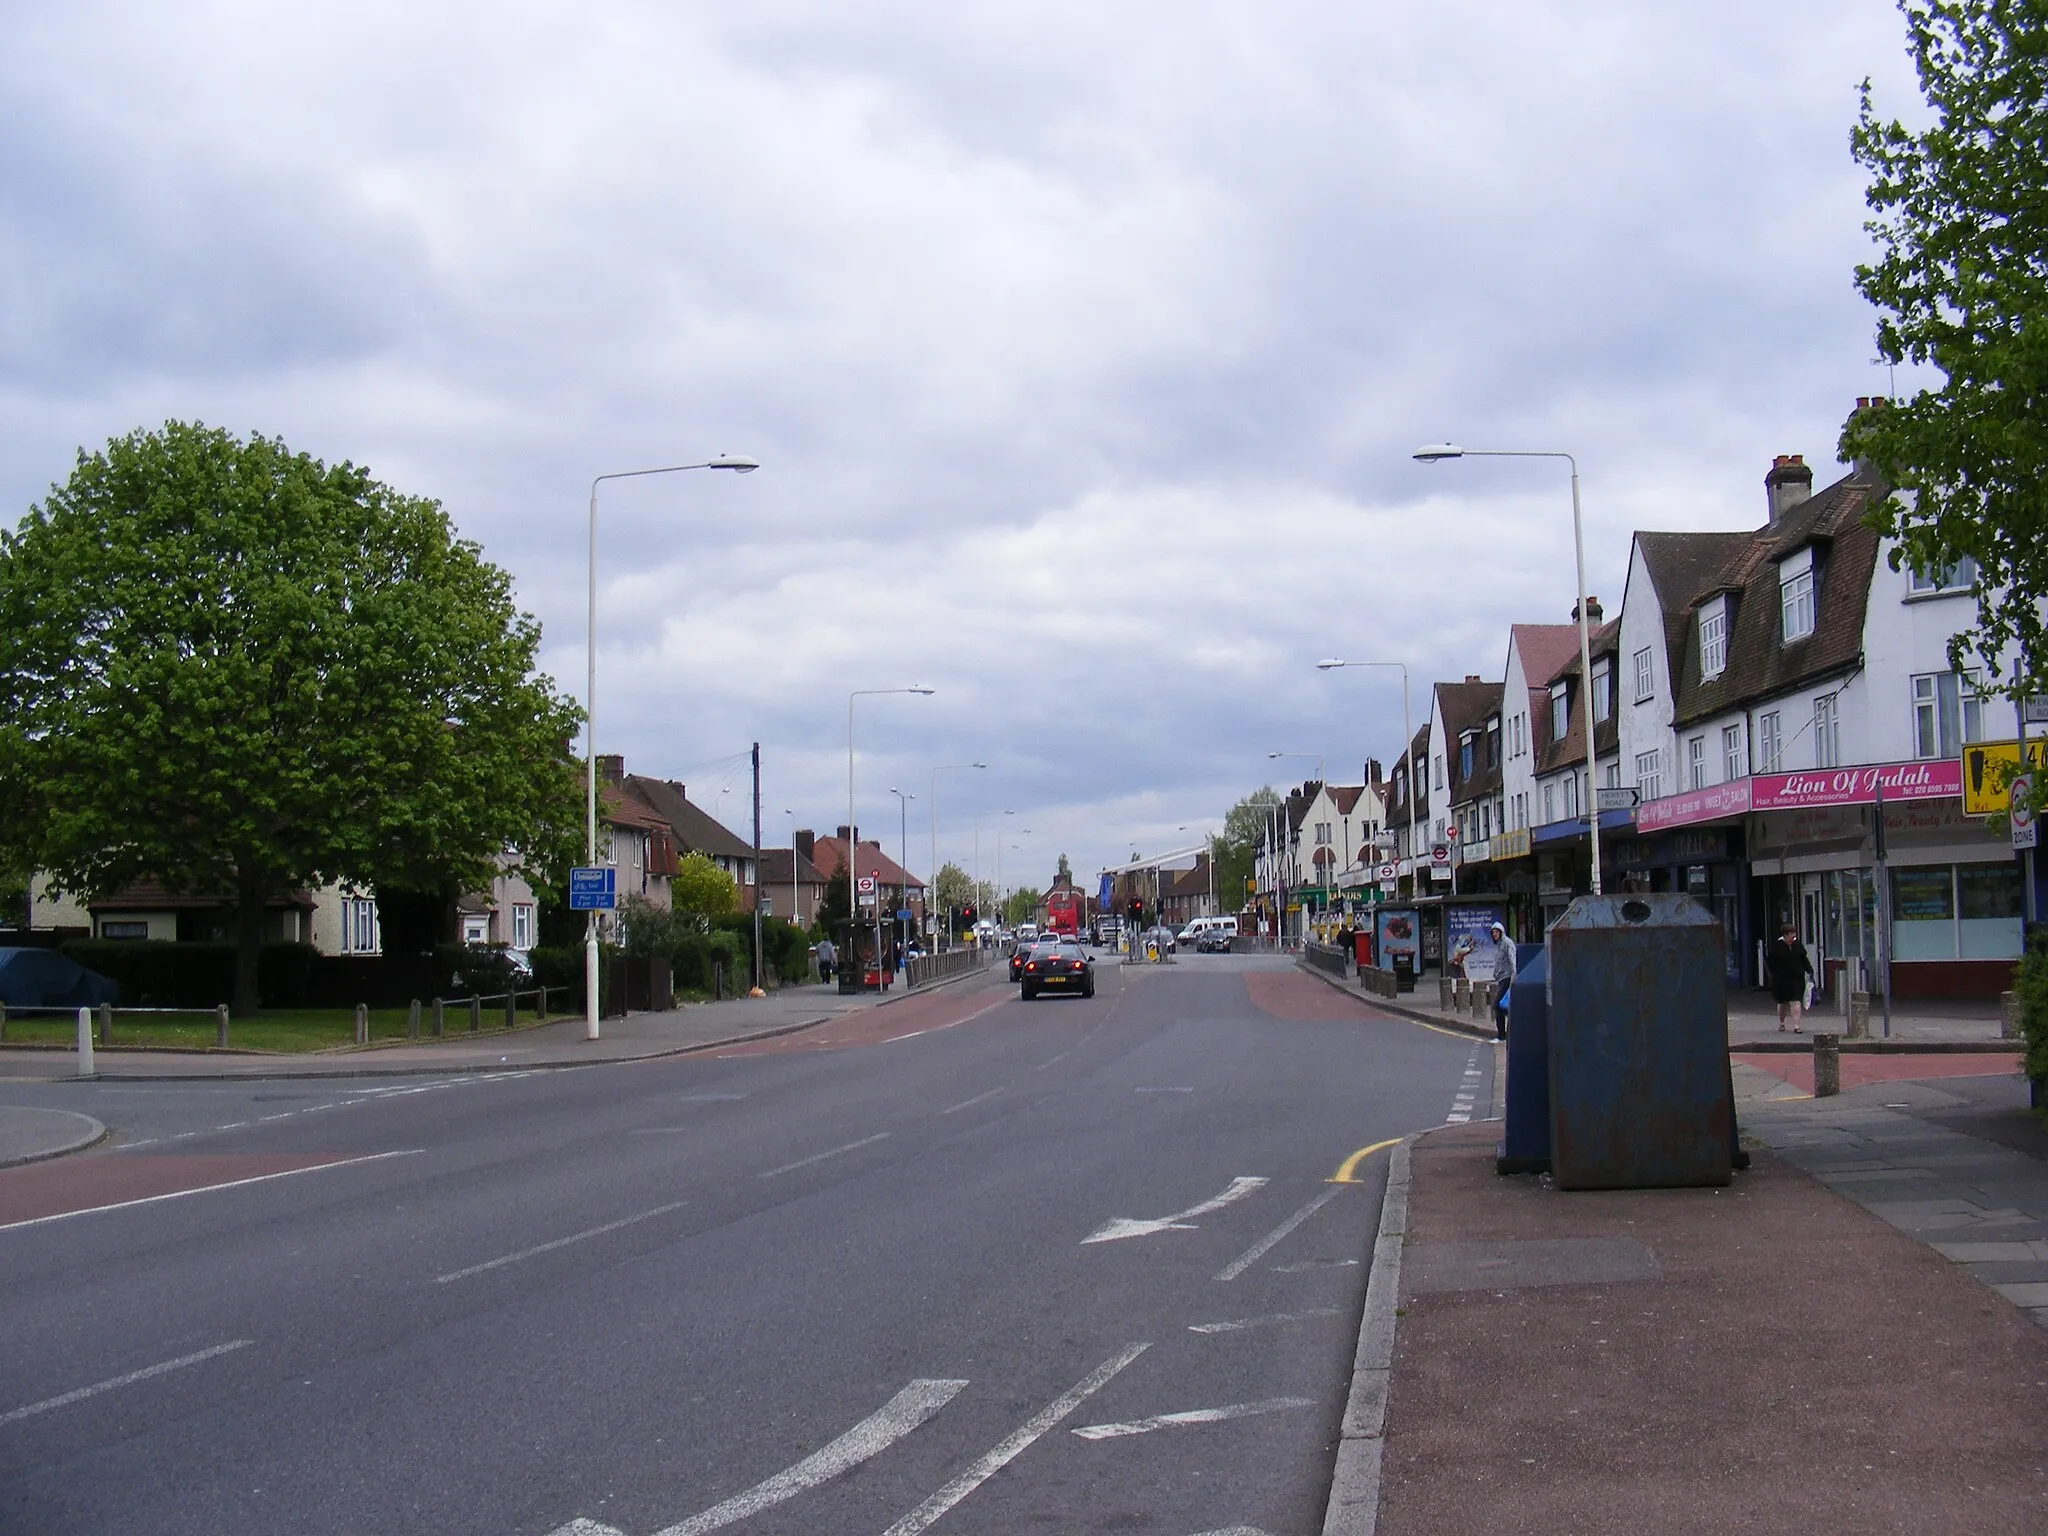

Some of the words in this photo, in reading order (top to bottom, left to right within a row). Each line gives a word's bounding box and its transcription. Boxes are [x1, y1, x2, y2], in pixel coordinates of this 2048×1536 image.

[1780, 776, 1826, 795] Lion
[1833, 770, 1859, 794] Of
[1863, 765, 1930, 792] Judah
[1601, 791, 1629, 799] HEWETT
[1730, 787, 1748, 803] SALON
[1903, 787, 1913, 795] Tel:
[1773, 796, 1798, 805] Beauty
[1806, 793, 1849, 802] Accessories
[2014, 829, 2033, 844] ZONE
